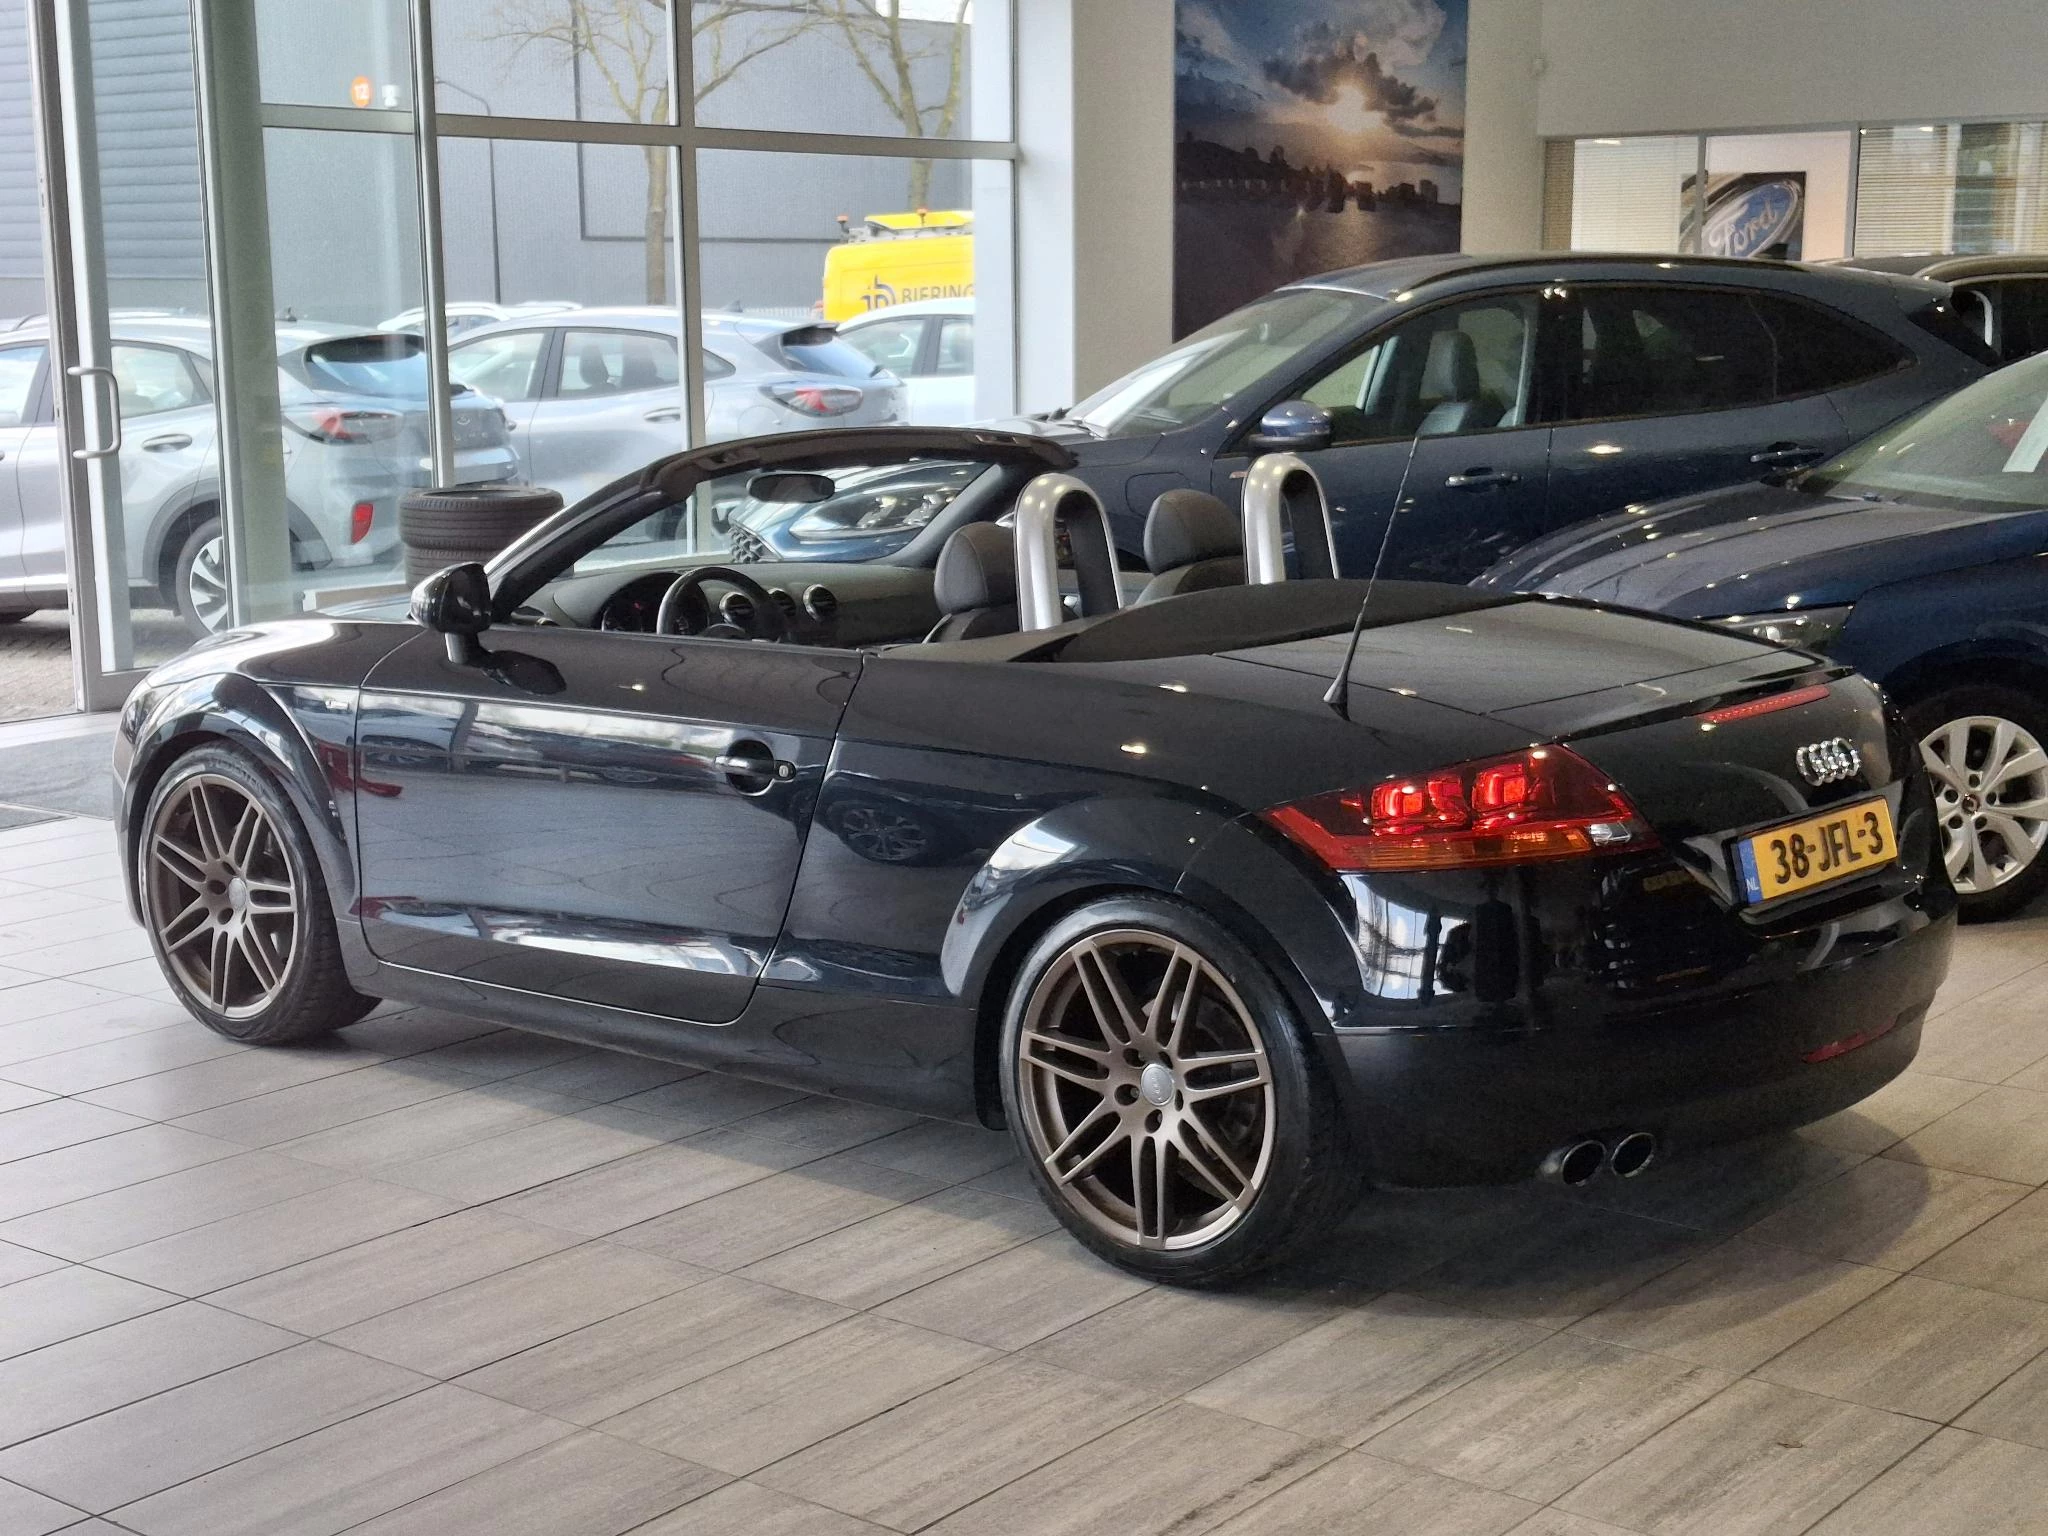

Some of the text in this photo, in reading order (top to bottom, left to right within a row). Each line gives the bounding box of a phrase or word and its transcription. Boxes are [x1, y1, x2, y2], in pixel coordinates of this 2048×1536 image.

[1709, 199, 1779, 256] Ford
[1770, 811, 1884, 885] 38-JFL-3
[1745, 880, 1760, 893] NL
